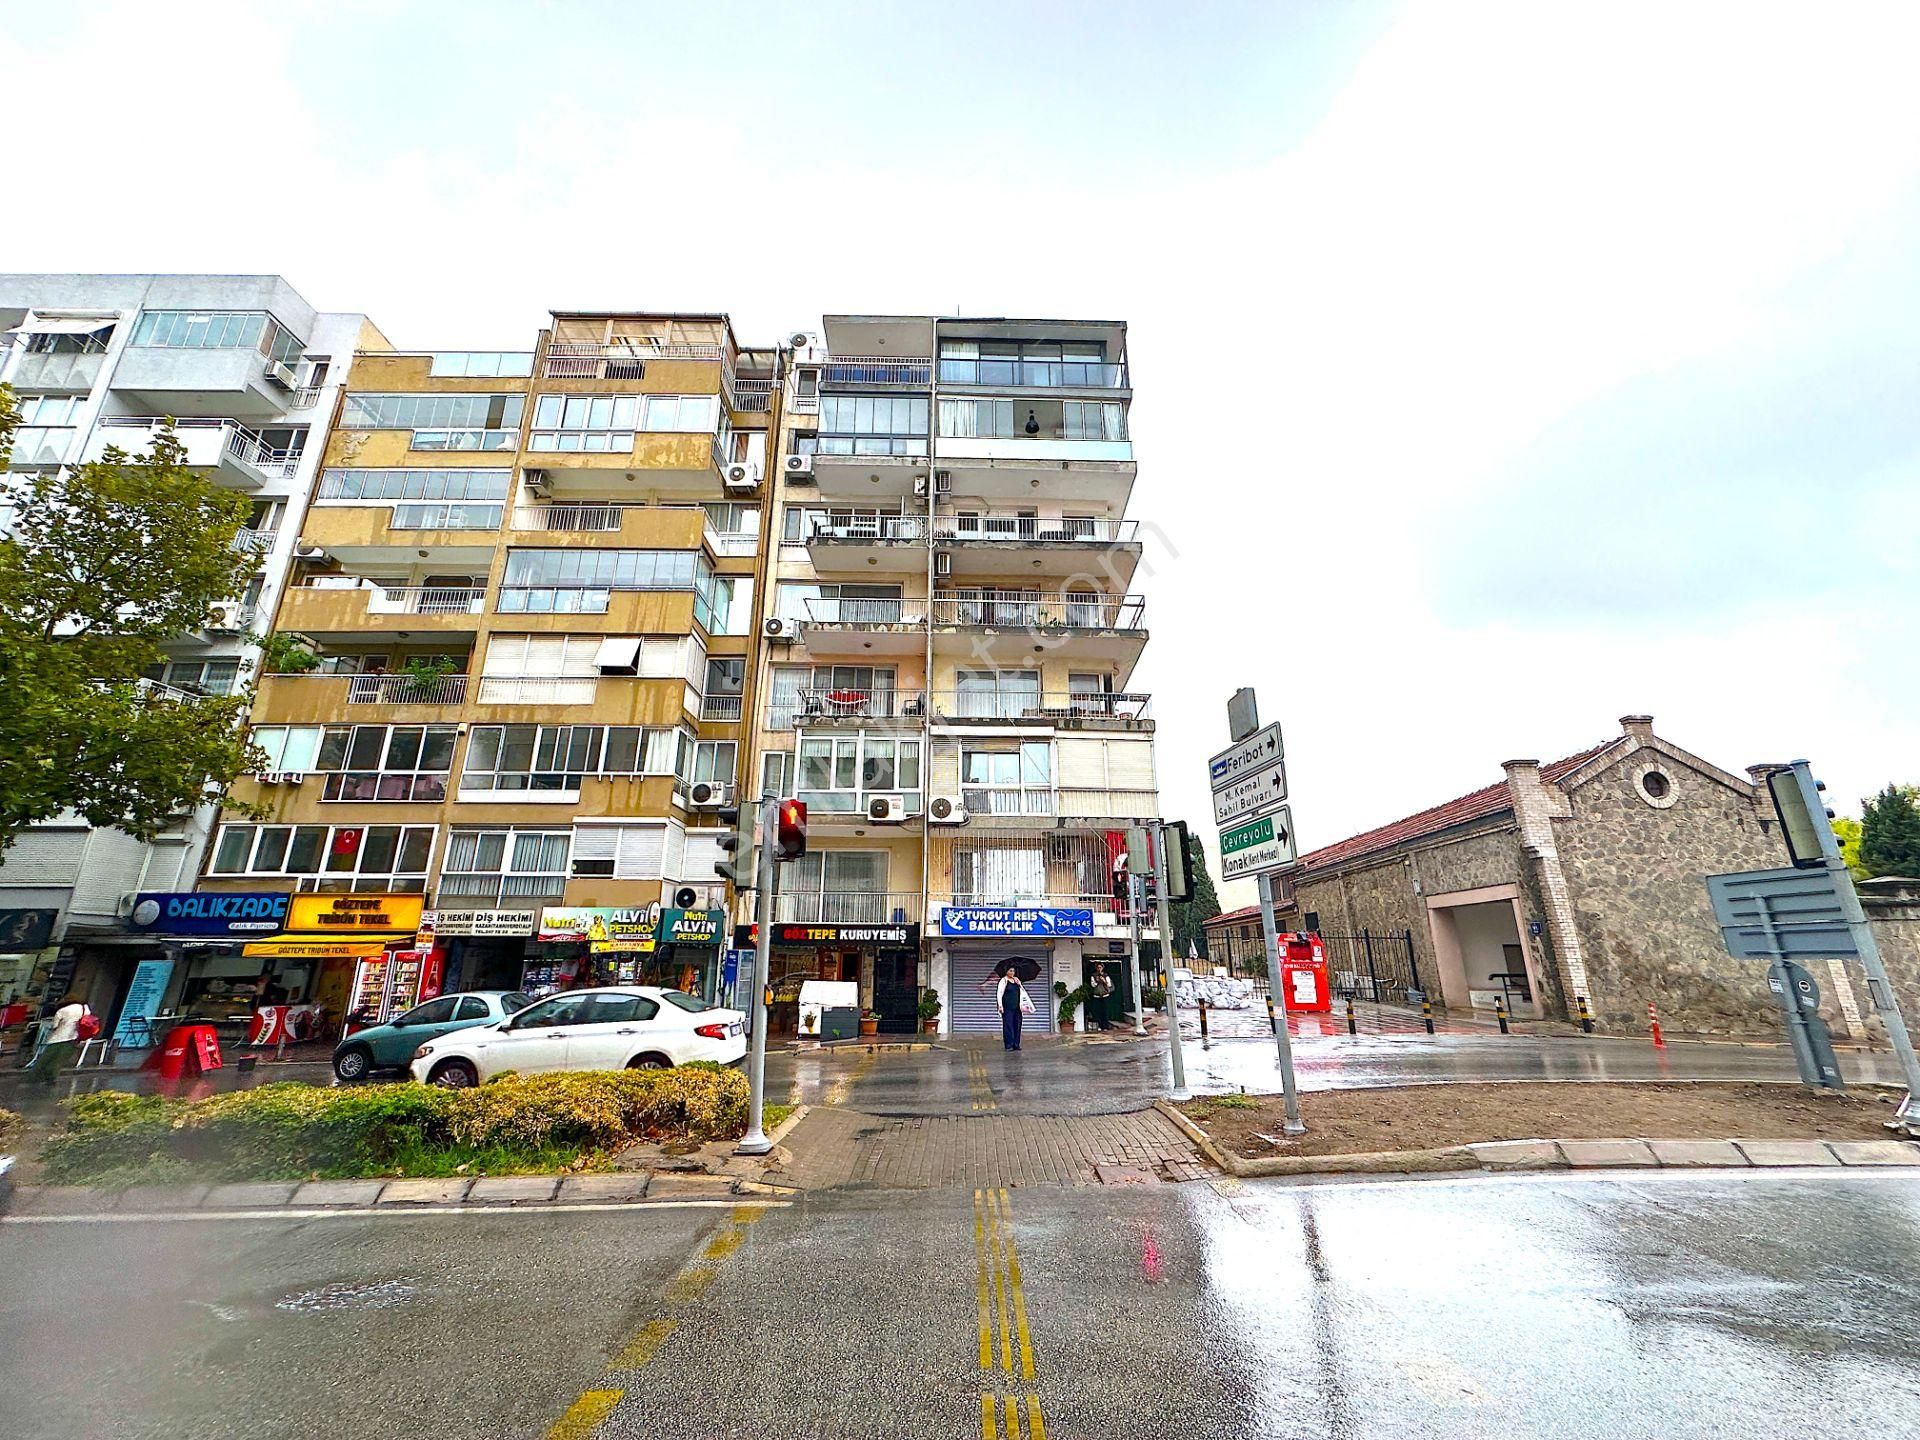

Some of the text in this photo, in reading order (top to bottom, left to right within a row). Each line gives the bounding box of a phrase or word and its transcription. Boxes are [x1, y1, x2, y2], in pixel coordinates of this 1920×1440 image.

[1226, 743, 1263, 773] Feribot
[1225, 776, 1261, 801] M. Kemal
[1218, 789, 1272, 818] Sahil Bulvarı
[1223, 821, 1271, 850] Çevreyolu
[1223, 851, 1249, 873] Konak
[168, 897, 288, 918] BALIKZADE
[965, 909, 1038, 921] TURGUT REİS
[447, 912, 475, 922] HEKİMİ
[476, 912, 533, 923] DİŞ HEKİMİ
[544, 916, 576, 928] Nutri
[684, 911, 708, 921] Nutri
[609, 923, 653, 934] PETSHOP
[783, 926, 907, 943] GÖZTEPE KURUYEMİŞ
[969, 920, 1034, 934] BALIKÇILIK
